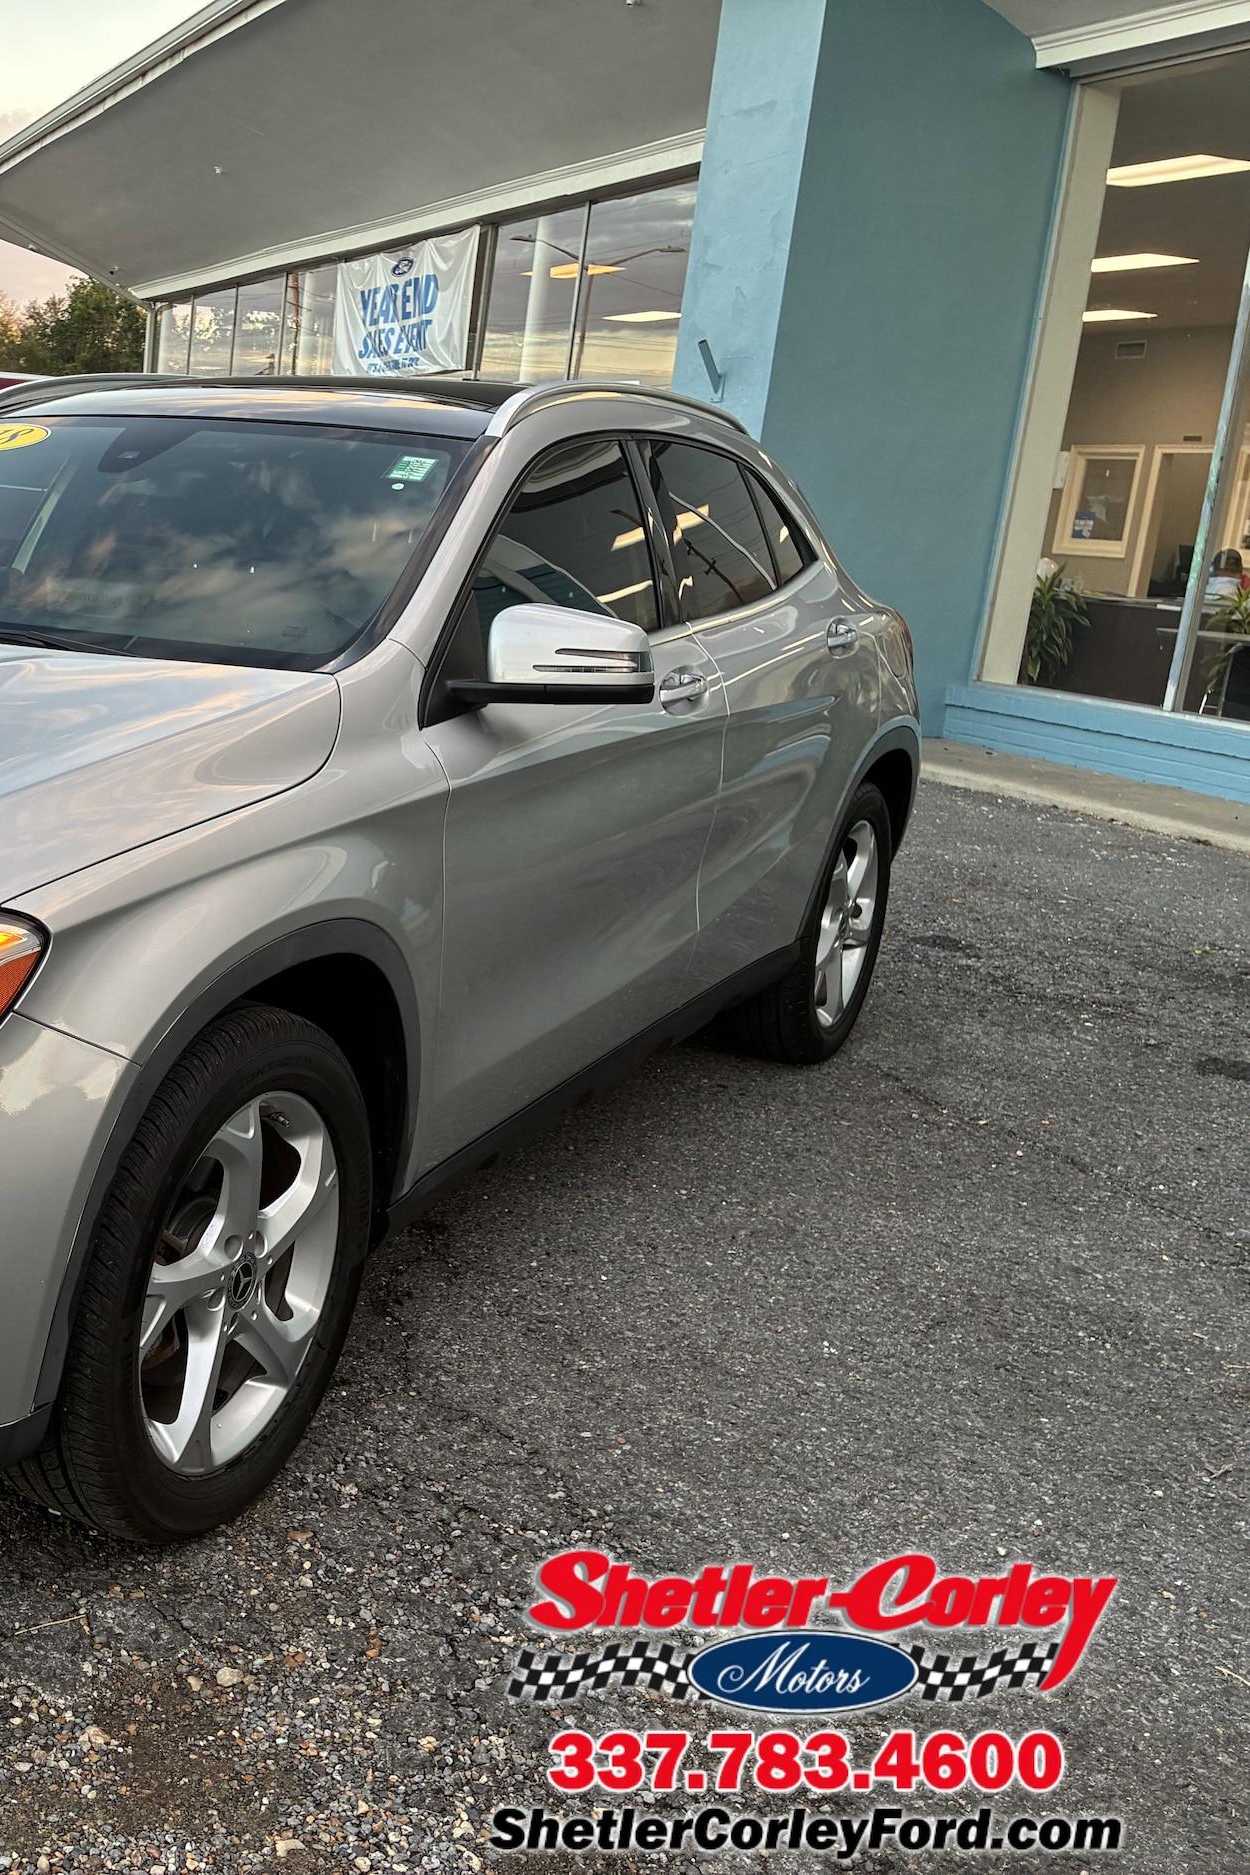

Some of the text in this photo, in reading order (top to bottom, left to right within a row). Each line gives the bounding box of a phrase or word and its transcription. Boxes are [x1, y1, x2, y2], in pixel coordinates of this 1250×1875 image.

[360, 274, 440, 329] YEAR END
[393, 319, 433, 355] EVENT
